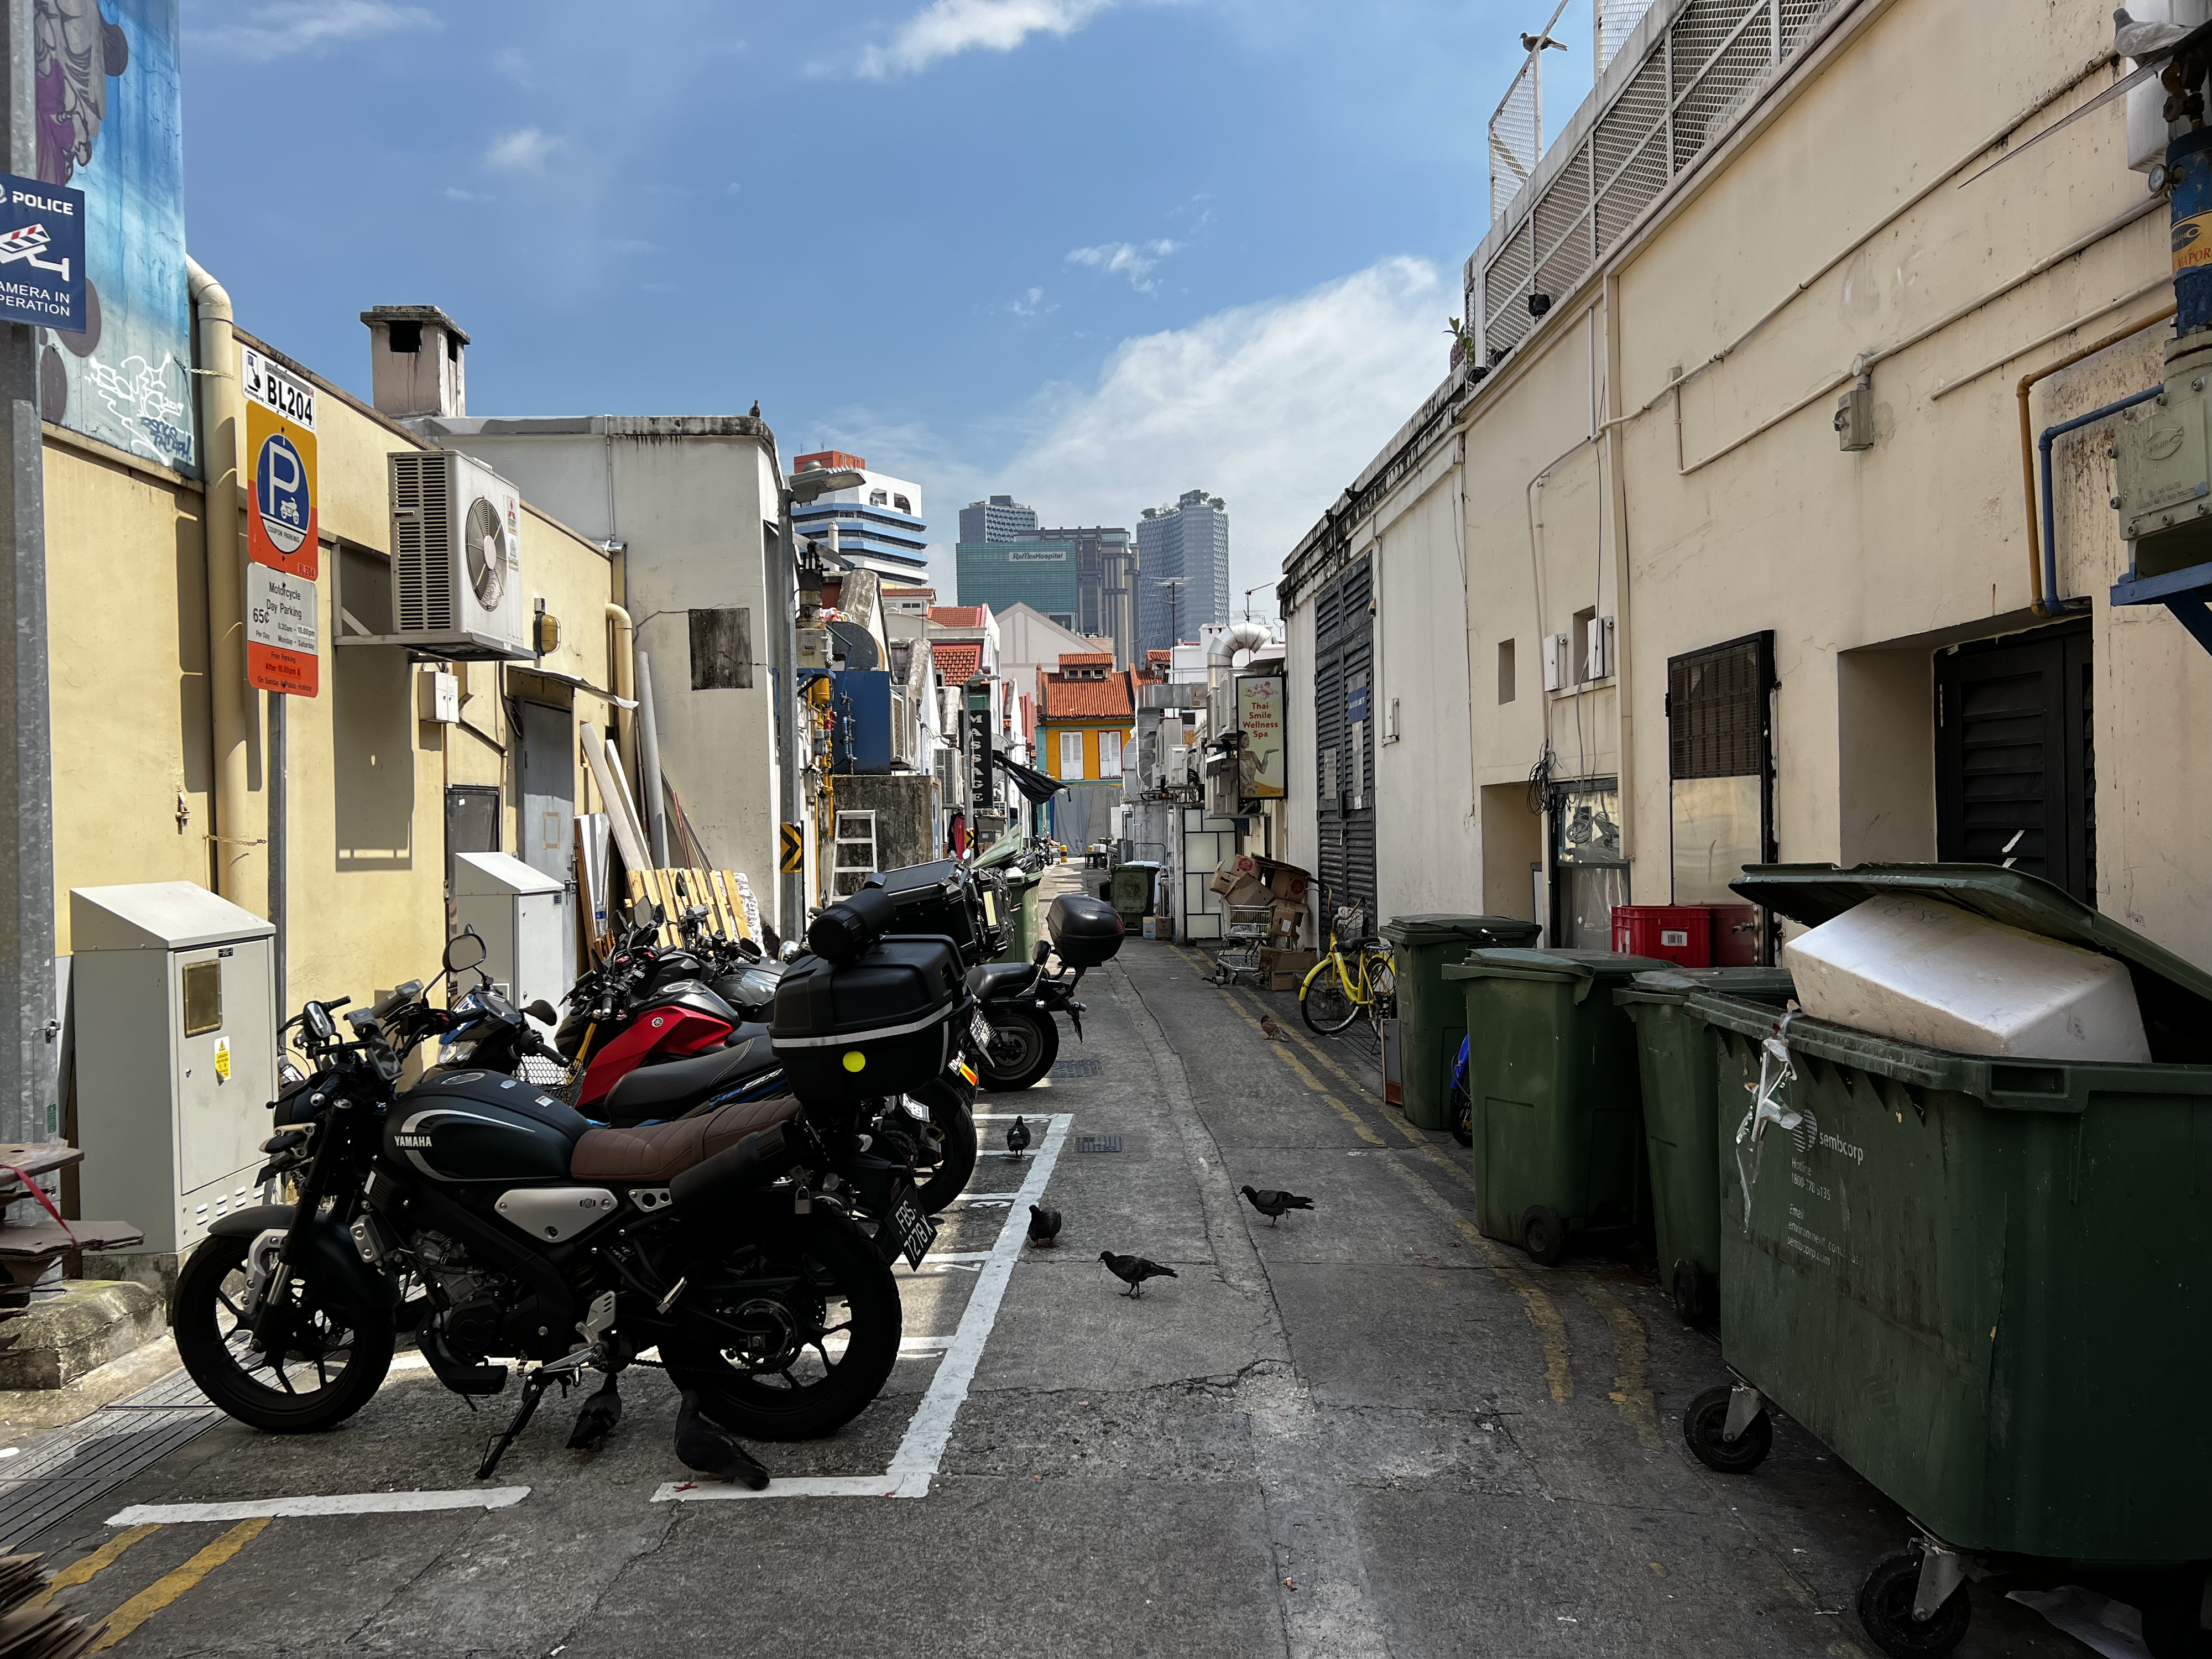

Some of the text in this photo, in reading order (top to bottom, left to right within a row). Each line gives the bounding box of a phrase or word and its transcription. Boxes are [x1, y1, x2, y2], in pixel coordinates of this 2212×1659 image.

[13, 191, 74, 215] POLICE
[55, 291, 70, 304] IN
[267, 374, 312, 426] BL204
[269, 441, 300, 515] P
[267, 525, 300, 543] COUPON PARKING
[269, 581, 301, 601] Motorcycle
[267, 598, 302, 620] Day Parking
[278, 635, 293, 646] Monday
[298, 640, 315, 650] Saturday
[271, 651, 296, 664] Free Parking
[265, 663, 276, 672] After
[265, 677, 279, 687] Sunday
[1253, 731, 1268, 739] Spa
[970, 715, 984, 801] MASSAGE
[394, 1135, 432, 1147] YAMAHA
[1819, 1132, 1864, 1166] sembcorp
[895, 1200, 916, 1233] FBS
[1790, 1203, 1804, 1220] Email
[1787, 1237, 1830, 1266] sembcorp.com
